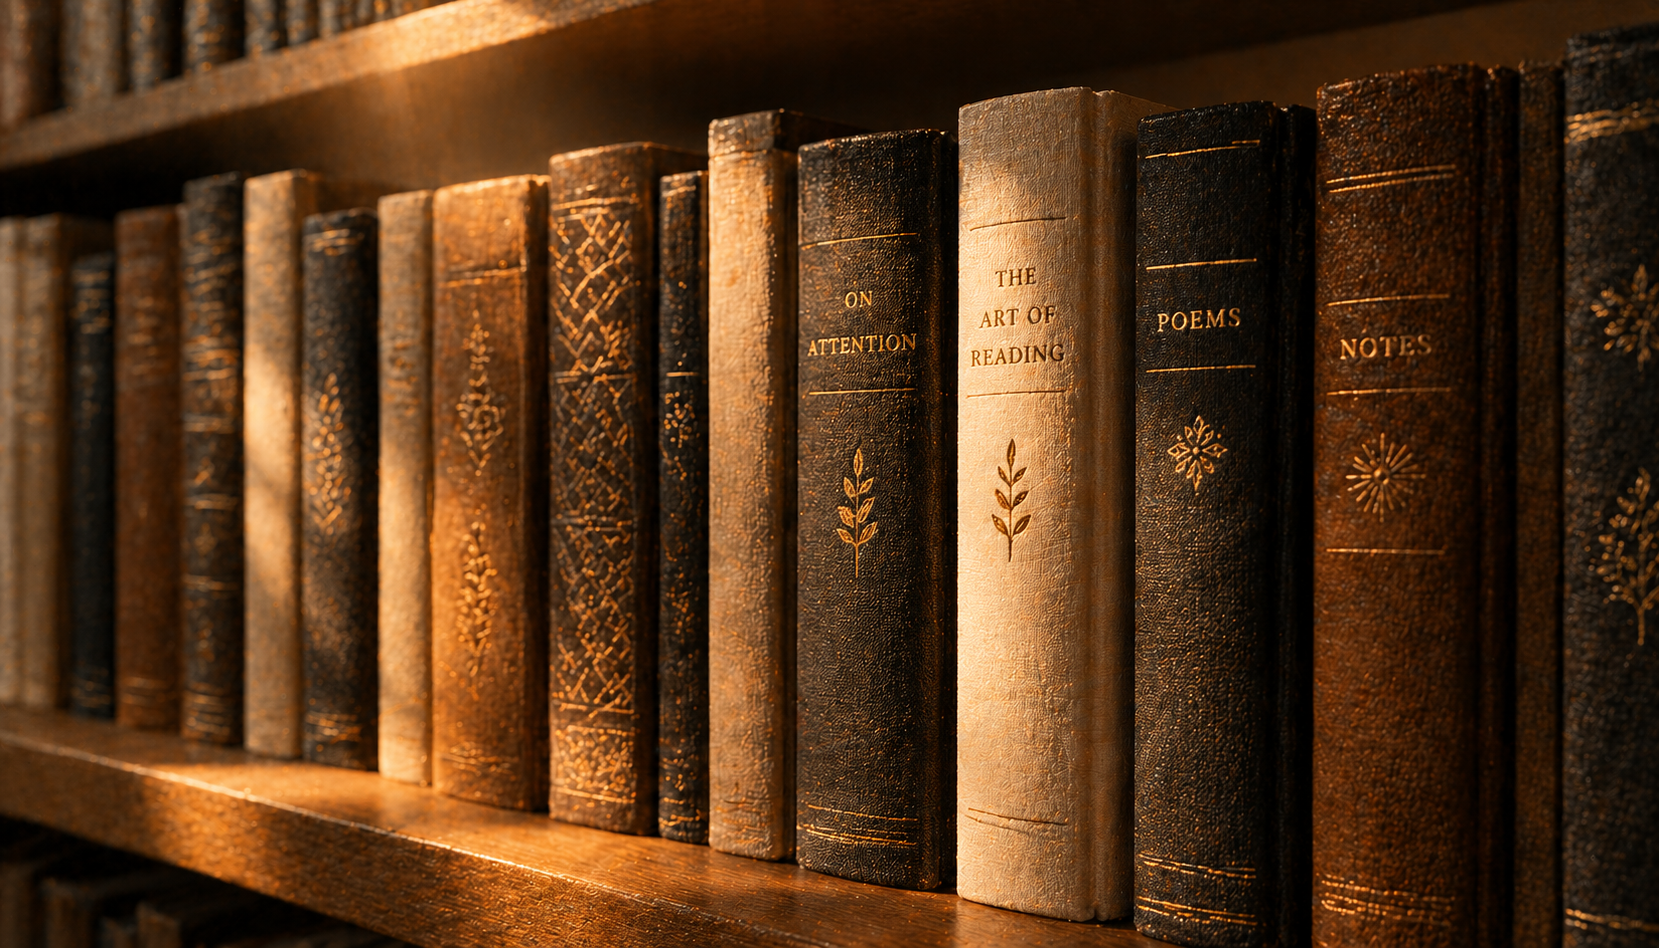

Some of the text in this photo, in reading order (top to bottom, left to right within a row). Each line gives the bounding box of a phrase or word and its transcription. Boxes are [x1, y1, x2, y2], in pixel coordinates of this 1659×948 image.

[995, 267, 1037, 288] THE
[845, 291, 873, 308] ON
[979, 305, 1056, 329] ART OF
[1156, 307, 1242, 333] POEMS
[807, 333, 917, 356] ATTENTION
[970, 343, 1065, 367] READING
[1339, 334, 1432, 360] NOTES
